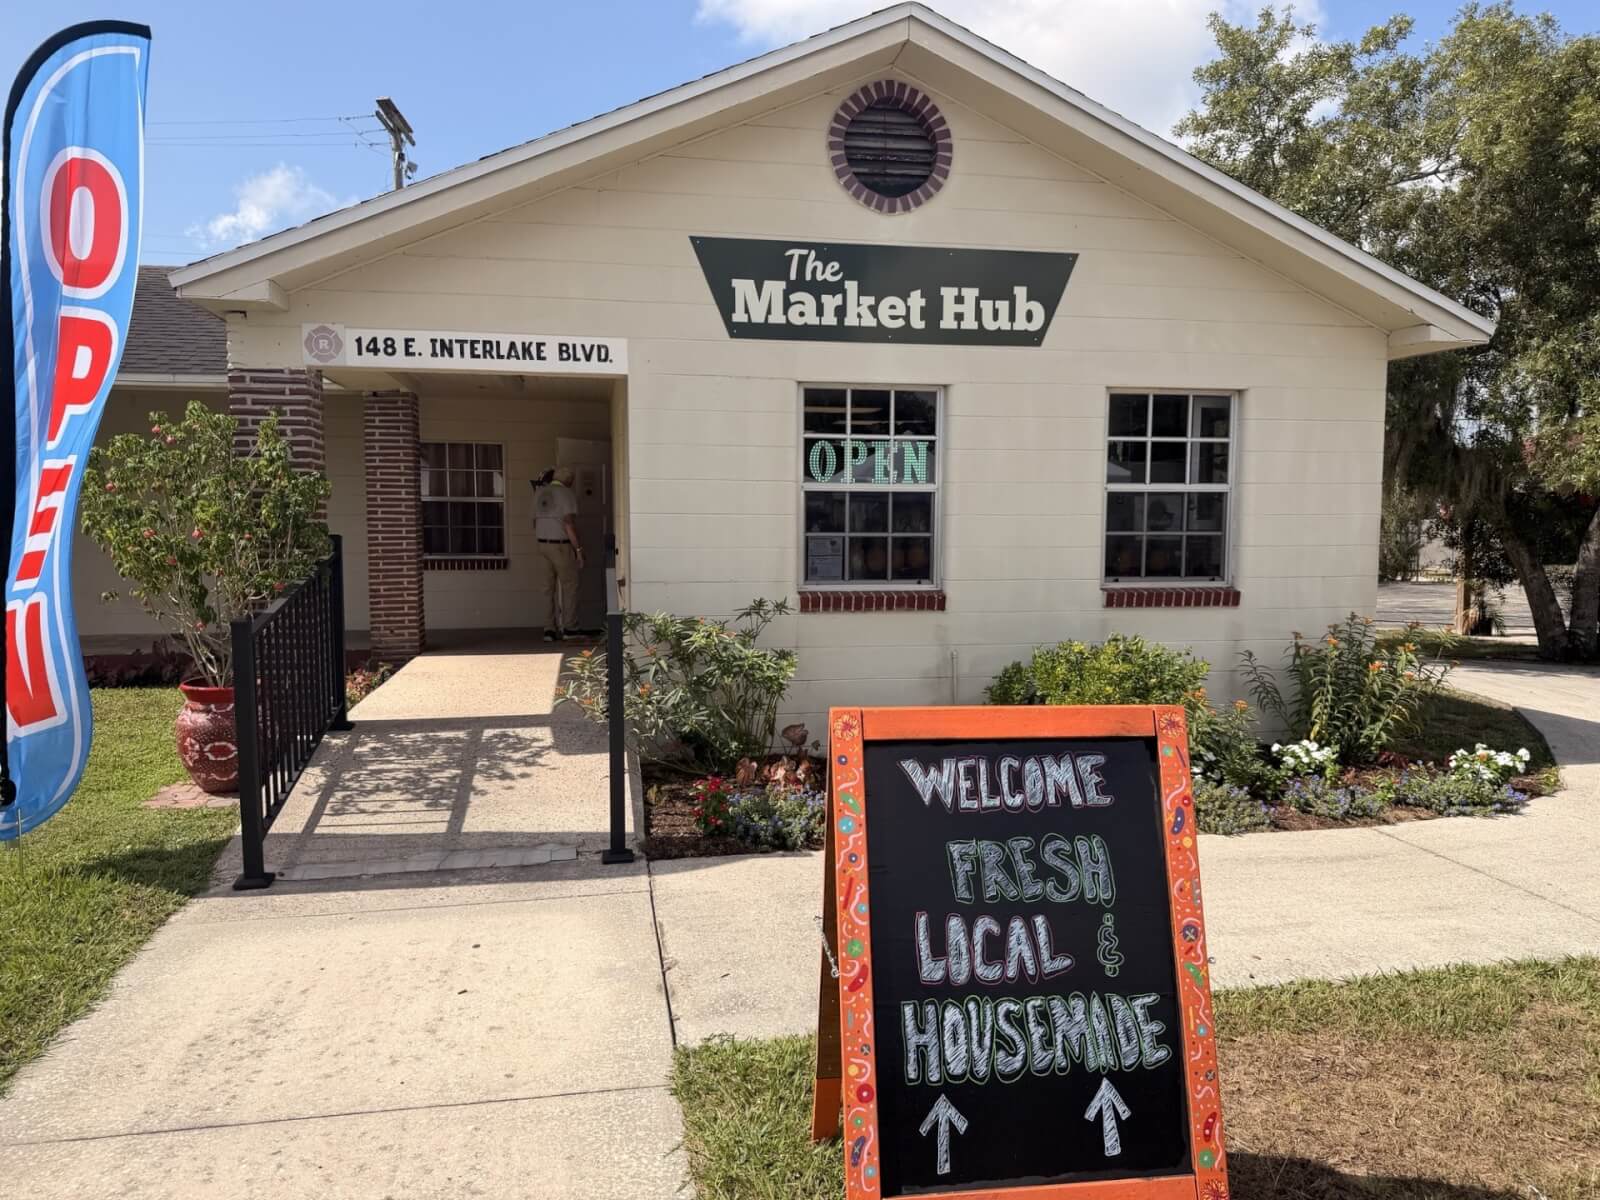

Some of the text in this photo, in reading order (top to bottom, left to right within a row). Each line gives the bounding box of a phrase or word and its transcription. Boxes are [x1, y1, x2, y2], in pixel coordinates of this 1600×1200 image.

[784, 248, 844, 283] The
[731, 278, 1046, 332] Market Hub
[354, 336, 614, 364] 148 E. INTERLAKE BLVD.
[808, 440, 930, 485] OPEN
[899, 751, 1115, 812] WELCOME
[946, 833, 1116, 908] FRESH
[914, 911, 1124, 985] LOCAL &
[901, 991, 1171, 1086] HOUSEMADE
